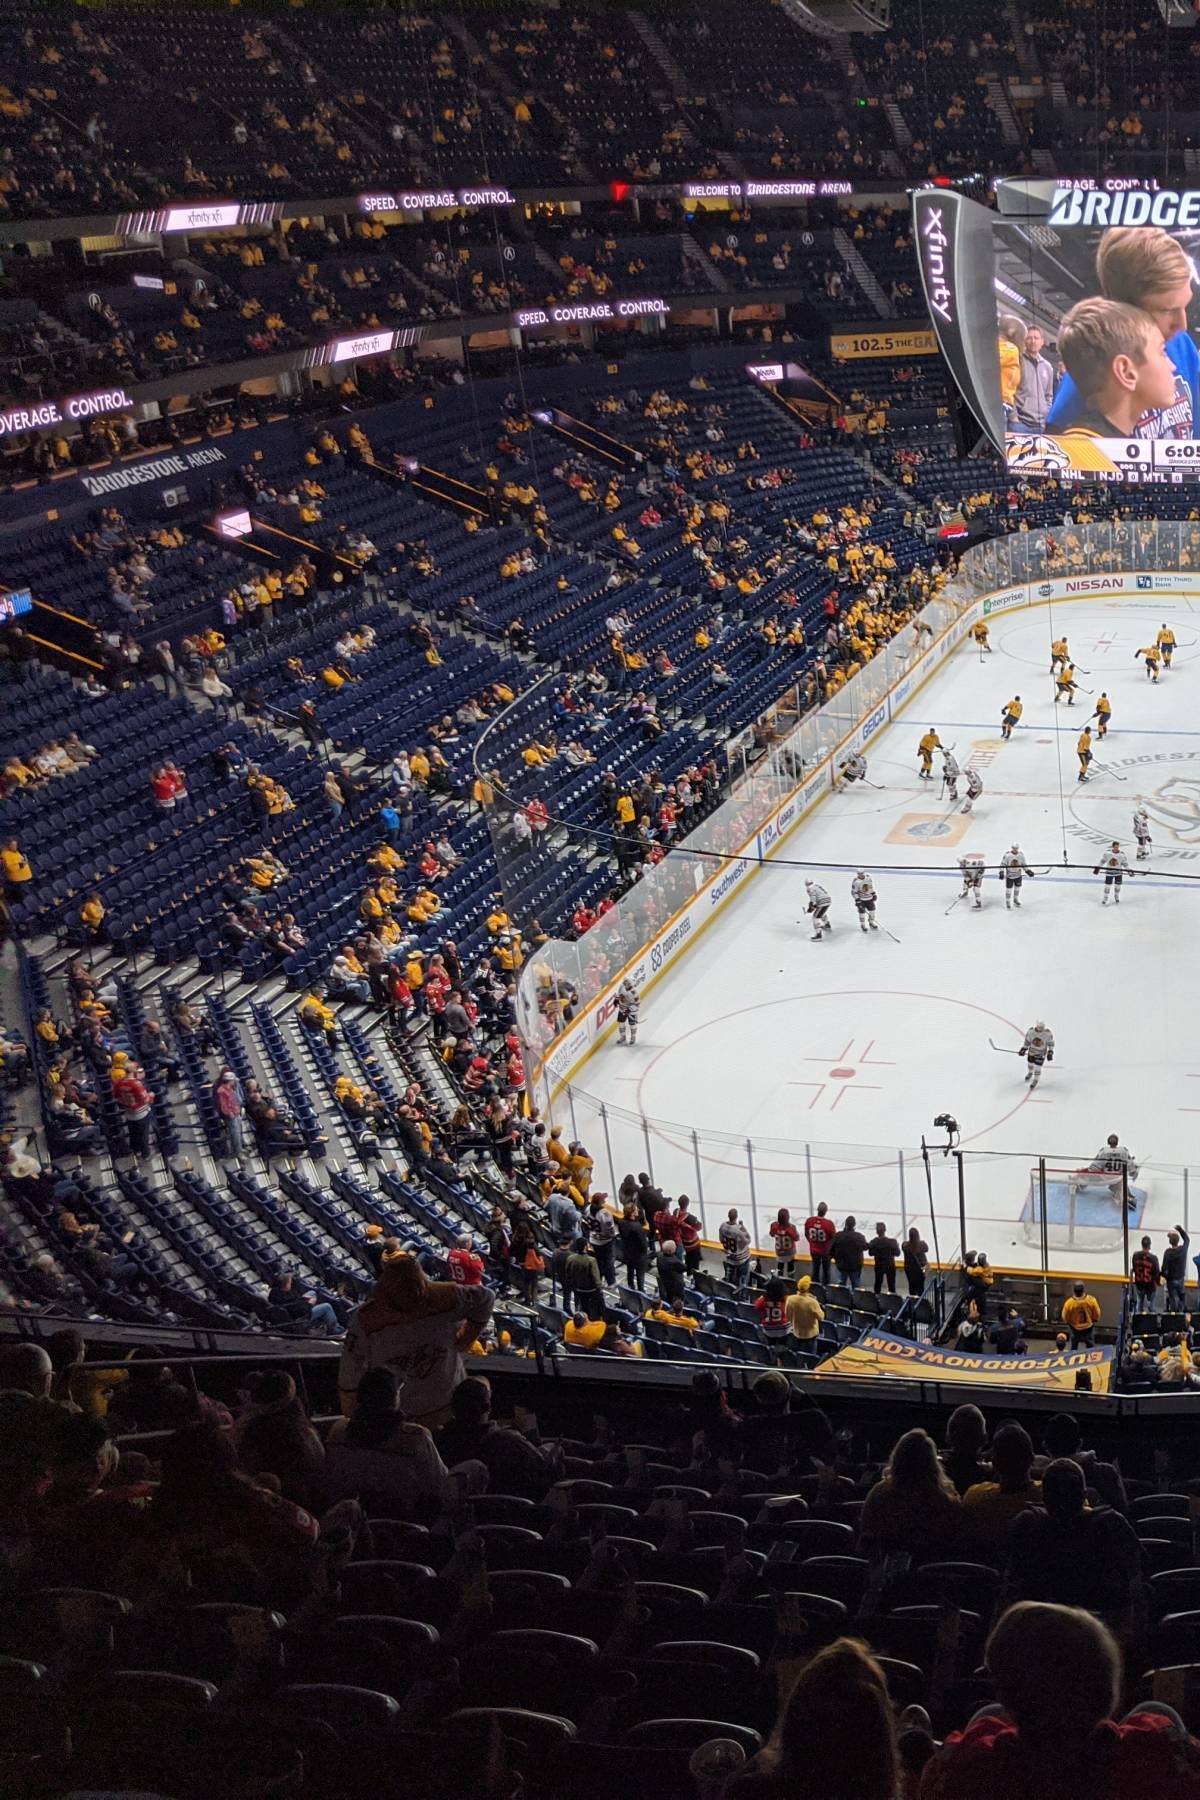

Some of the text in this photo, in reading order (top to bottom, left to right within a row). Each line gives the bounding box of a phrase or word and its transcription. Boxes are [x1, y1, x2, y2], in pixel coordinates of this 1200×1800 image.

[689, 181, 852, 197] WELCOME TO BRIDGESTONE ARENA
[364, 190, 516, 212] SPEED. COVERAGE. CONTROL.
[924, 207, 952, 323] xfinity
[519, 299, 671, 326] SPEED. COVERAGE. CONTROL.
[852, 338, 894, 352] 102.5
[895, 339, 913, 348] THE
[0, 389, 134, 434] OVERAGE. CONTROL.
[1126, 443, 1140, 459] 0
[81, 446, 226, 497] BRIDGESTONE ARENA
[1060, 468, 1086, 480] NHL
[1099, 471, 1125, 481] NJD
[1142, 472, 1168, 483] MTL
[1065, 577, 1124, 593] NISSAN
[983, 591, 1024, 613] enterprise
[862, 706, 886, 741] GEICO
[710, 860, 746, 905] Southwest
[1104, 1160, 1122, 1172] 40
[764, 1306, 783, 1322] 19
[862, 1335, 1104, 1371] BUYFORDNOW.COM
